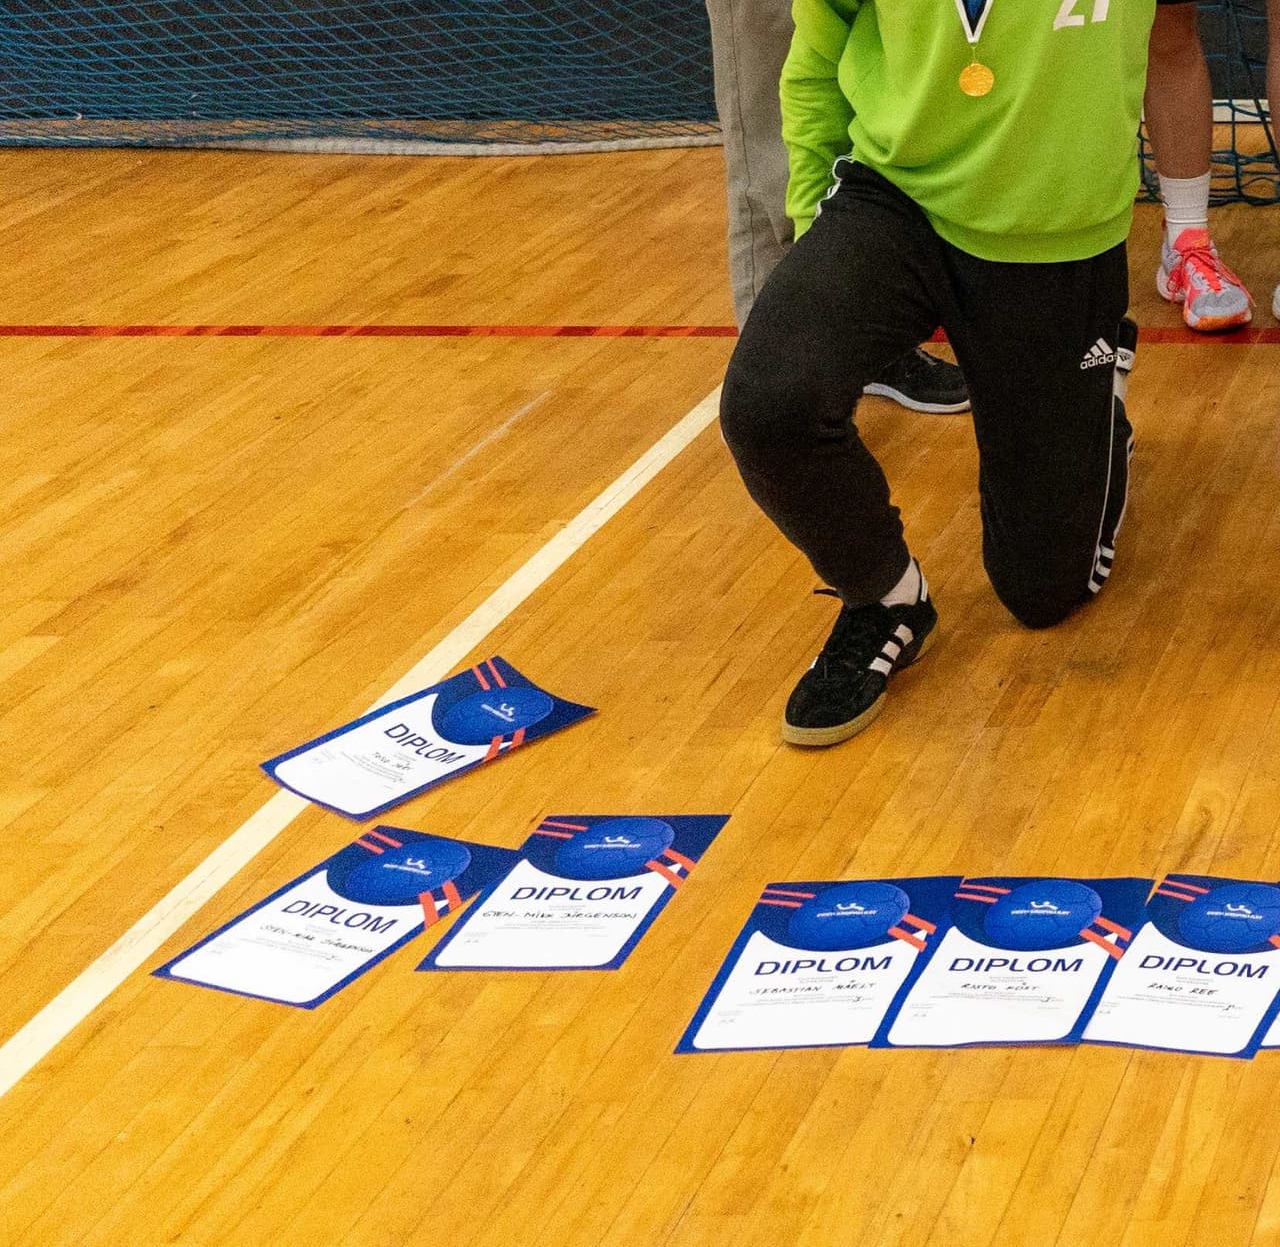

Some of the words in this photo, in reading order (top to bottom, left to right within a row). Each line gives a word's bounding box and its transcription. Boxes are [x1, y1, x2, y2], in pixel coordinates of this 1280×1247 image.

[383, 722, 467, 765] DIPLOM
[509, 886, 644, 901] DIPLOM
[280, 899, 399, 935] DIPLOM
[754, 955, 894, 976] DIPLOM
[949, 957, 1084, 972] DIPLOM
[1138, 955, 1269, 979] DIPLOM
